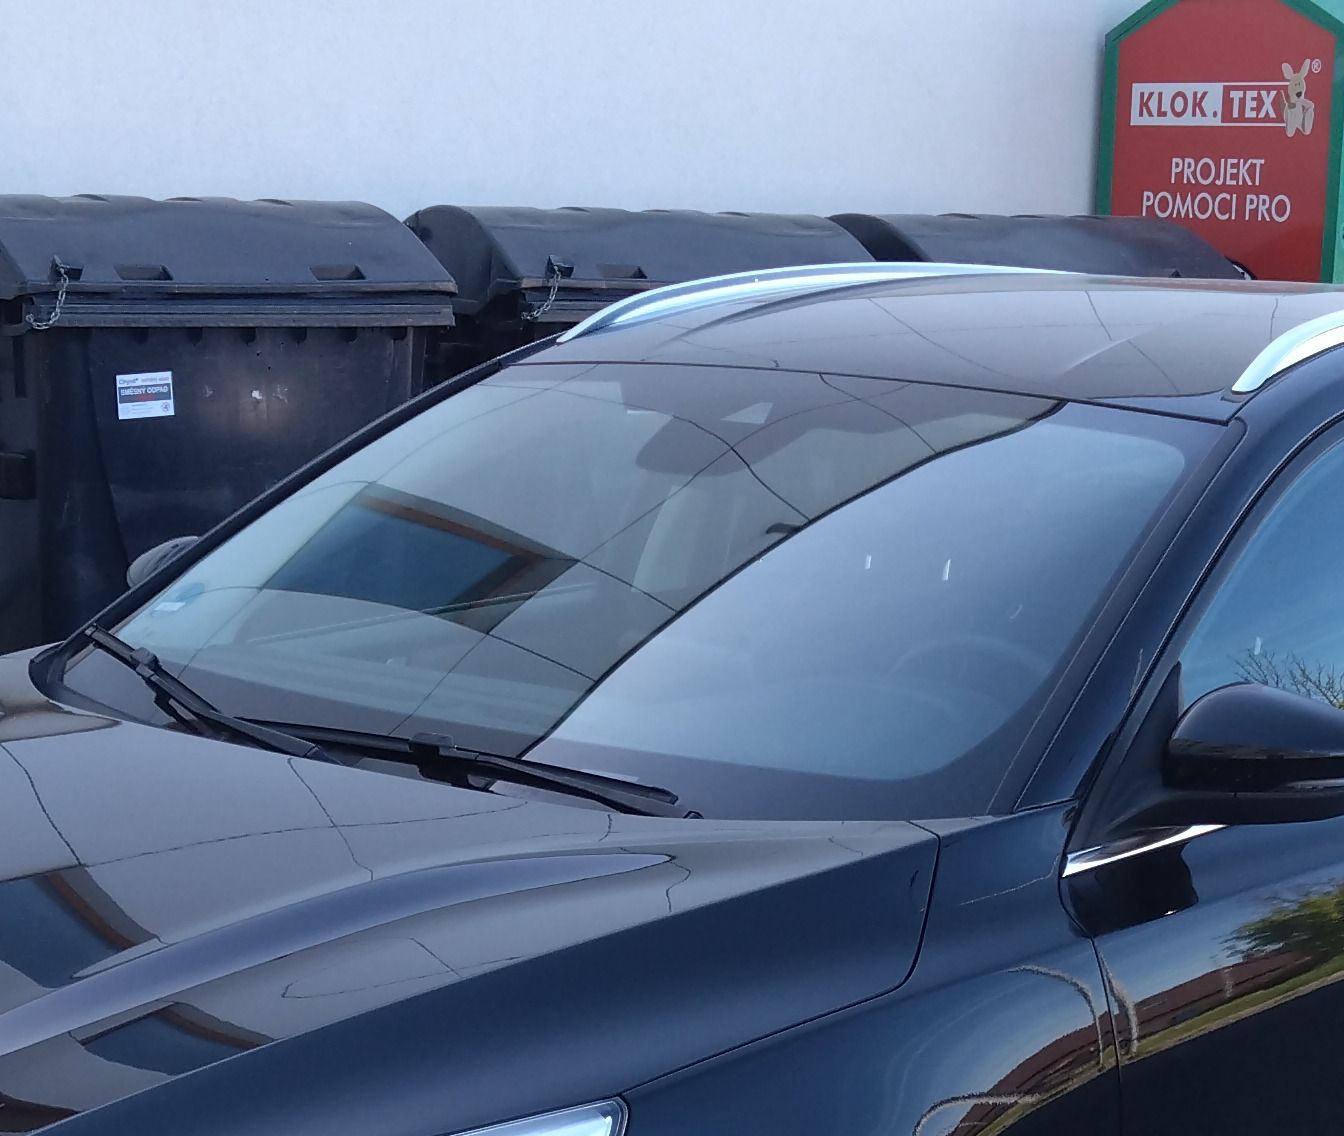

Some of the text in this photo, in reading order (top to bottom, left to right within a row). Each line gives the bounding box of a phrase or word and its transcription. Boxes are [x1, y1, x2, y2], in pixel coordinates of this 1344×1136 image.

[1229, 90, 1277, 118] TEX
[1170, 157, 1265, 186] PROJEKT
[1142, 191, 1291, 222] POMOCI PRO
